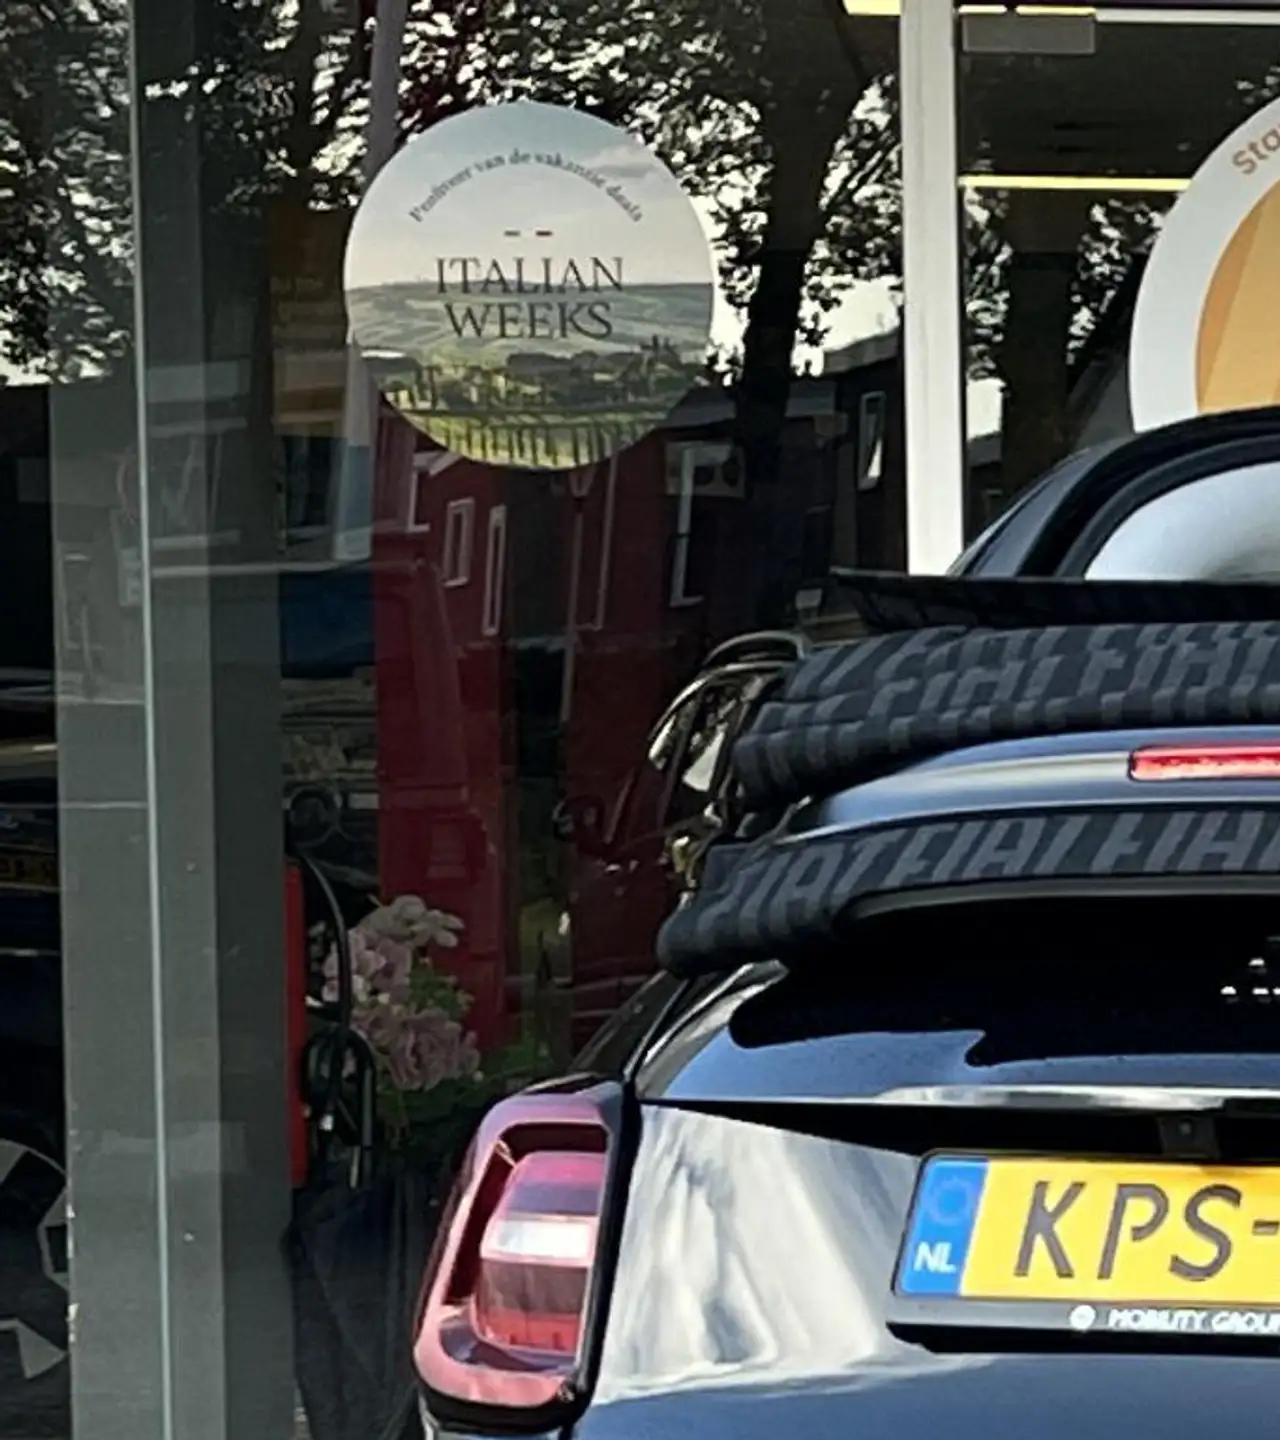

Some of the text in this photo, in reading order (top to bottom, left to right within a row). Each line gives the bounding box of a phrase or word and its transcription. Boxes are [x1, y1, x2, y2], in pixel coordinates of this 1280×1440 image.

[509, 147, 531, 165] de
[435, 256, 624, 295] ITALIAN
[444, 300, 615, 340] WEEKS
[913, 1241, 957, 1273] NL
[1108, 1308, 1208, 1332] MOBILITY
